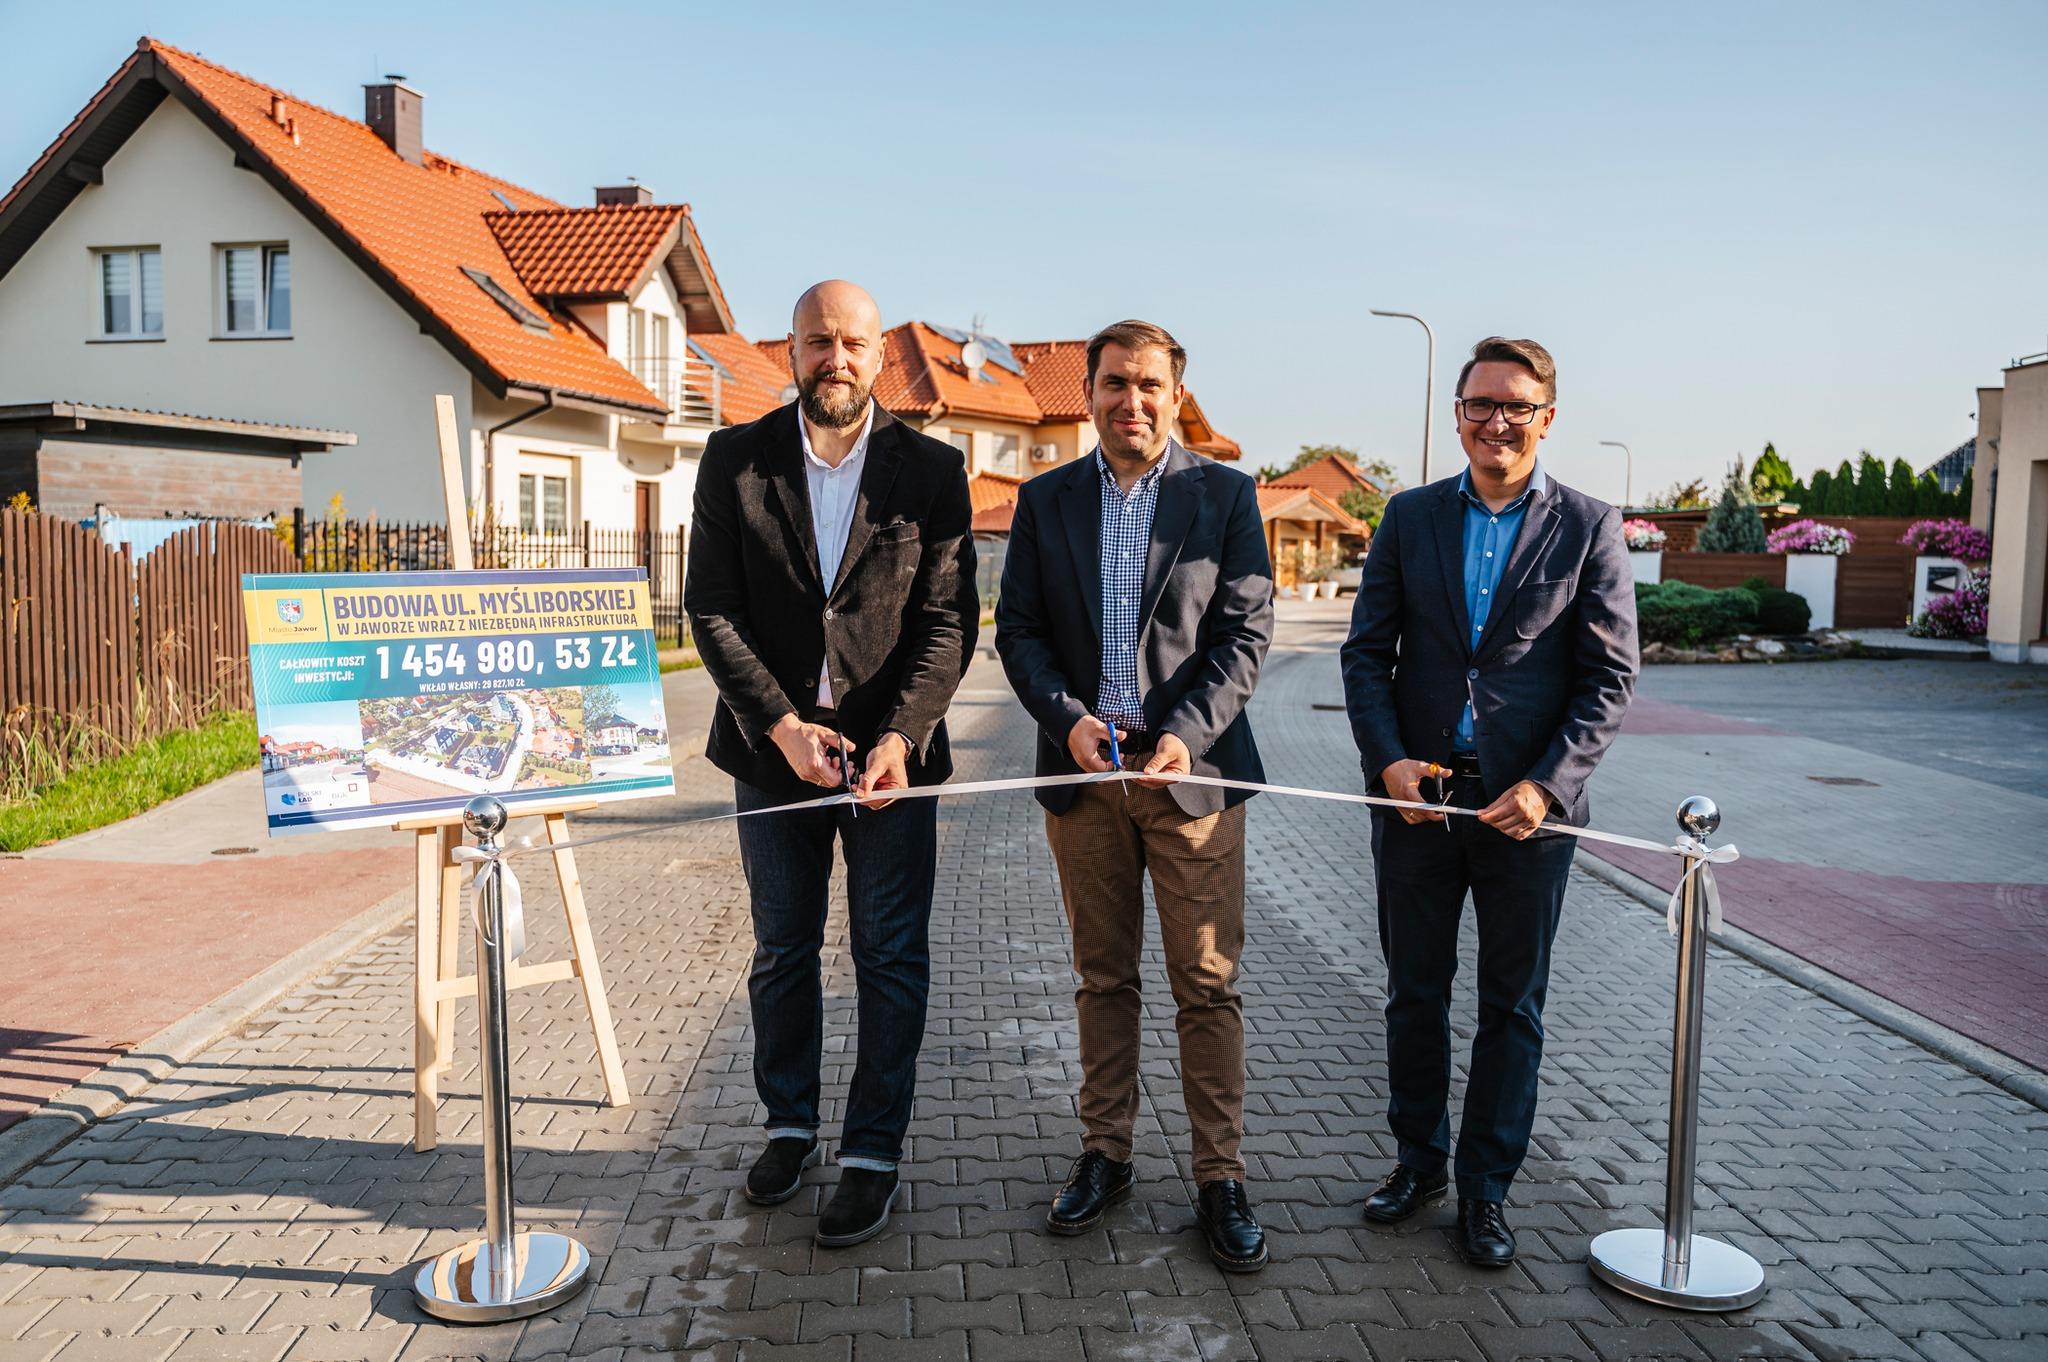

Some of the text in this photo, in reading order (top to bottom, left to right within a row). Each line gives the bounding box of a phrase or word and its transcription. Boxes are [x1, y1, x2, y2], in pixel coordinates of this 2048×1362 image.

[333, 587, 636, 619] BUDOWA UL. MYŚLIBORSKIEJ
[337, 614, 638, 636] W JAWORZE WRAZ Z NIEZBĘDNĄ INFRASTRUKTURĄ
[279, 655, 366, 670] CAŁKOWITY KOSZT
[376, 636, 637, 680] 1 454 980, 53 ZŁ
[294, 672, 354, 684] INWESTYCJI:
[420, 682, 446, 693] WKŁAD
[448, 680, 480, 691] WŁASNY:
[516, 678, 526, 687] ZŁ
